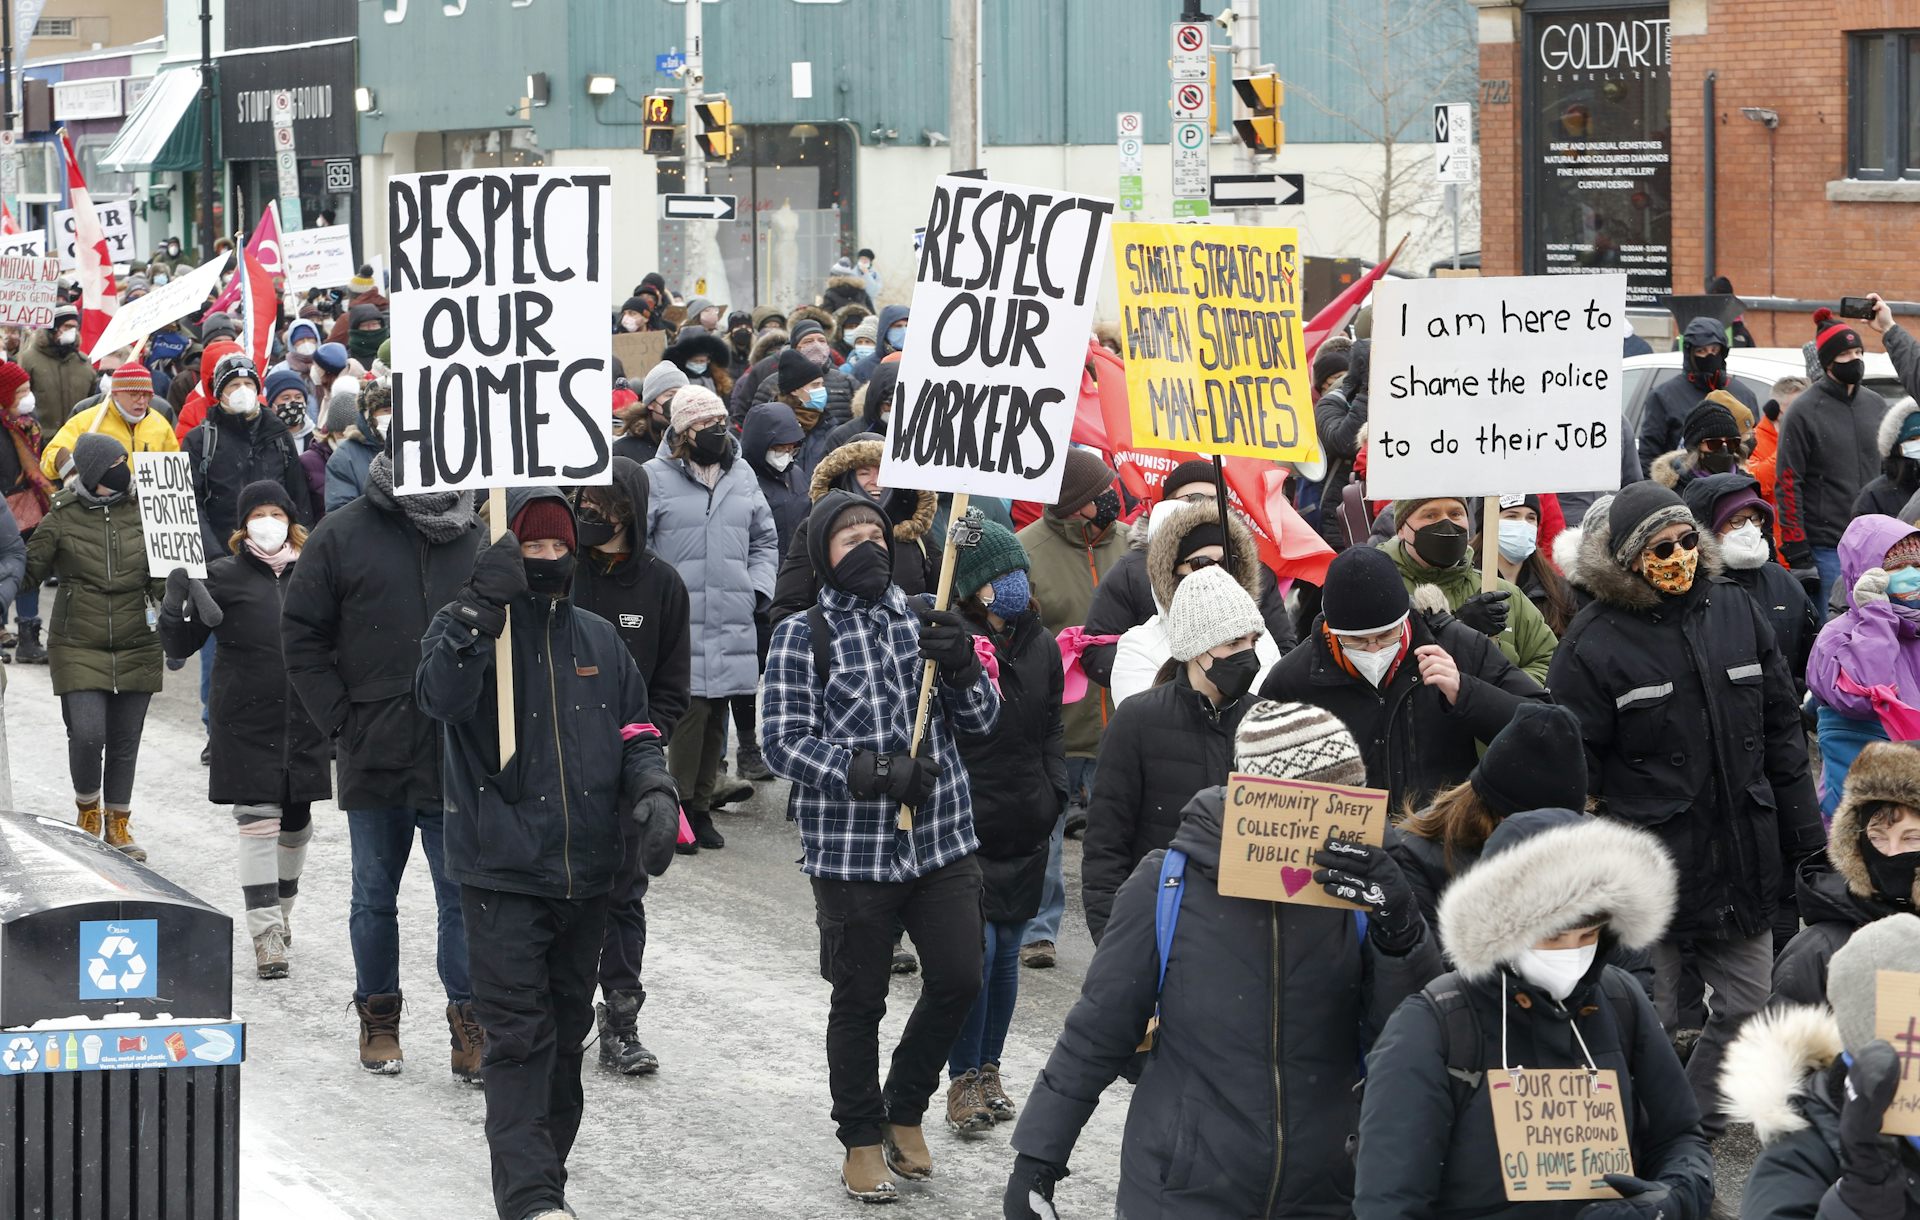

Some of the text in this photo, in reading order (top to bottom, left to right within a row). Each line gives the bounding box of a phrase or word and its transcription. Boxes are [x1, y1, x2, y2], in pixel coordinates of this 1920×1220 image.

[1541, 20, 1671, 70] GOLDART
[1481, 80, 1510, 104] 722
[1544, 154, 1670, 164] NATURAL AND COLOURED DIAMONDS
[1550, 141, 1663, 151] RARE AND UNUSUAL GEMSTONES
[1557, 167, 1656, 176] FINE HANDMADE JEWELLERY
[1578, 180, 1634, 189] CUSTOM DESIGN
[389, 173, 611, 293] RESPECT
[917, 185, 1115, 306] RESPECT
[0, 258, 60, 282] MUTUAL AID
[1125, 240, 1296, 304] SINGLE STRAIGHT
[1627, 268, 1667, 276] APPOINTMENT
[1649, 287, 1664, 295] CALL
[0, 306, 53, 325] PLAYED
[422, 291, 556, 359] OUR
[1401, 299, 1612, 338] I am here to
[931, 292, 1050, 369] OUR
[1124, 303, 1296, 371] WOMEN SUPPORT
[1390, 362, 1608, 399] shame the police
[392, 357, 610, 488] HOMES
[1147, 375, 1299, 449] MAN-DATES
[891, 379, 1066, 480] WORKERS
[1379, 422, 1608, 459] to do their JOB
[138, 456, 194, 492] #LOOK
[1144, 471, 1159, 487] OF
[150, 531, 204, 566] HELPERS
[1325, 793, 1373, 826] SAFETY
[1328, 825, 1366, 845] CARE
[1246, 843, 1300, 864] PUBLIC
[118, 1054, 135, 1062] metal
[147, 1054, 166, 1062] plastic
[141, 1061, 168, 1069] plastique
[1518, 1073, 1553, 1098] OUR
[1515, 1100, 1617, 1123] IS NOT YOUR
[1526, 1125, 1618, 1146] PLAYGROUND
[1504, 1151, 1529, 1179] GO
[1536, 1151, 1577, 1178] HOME
